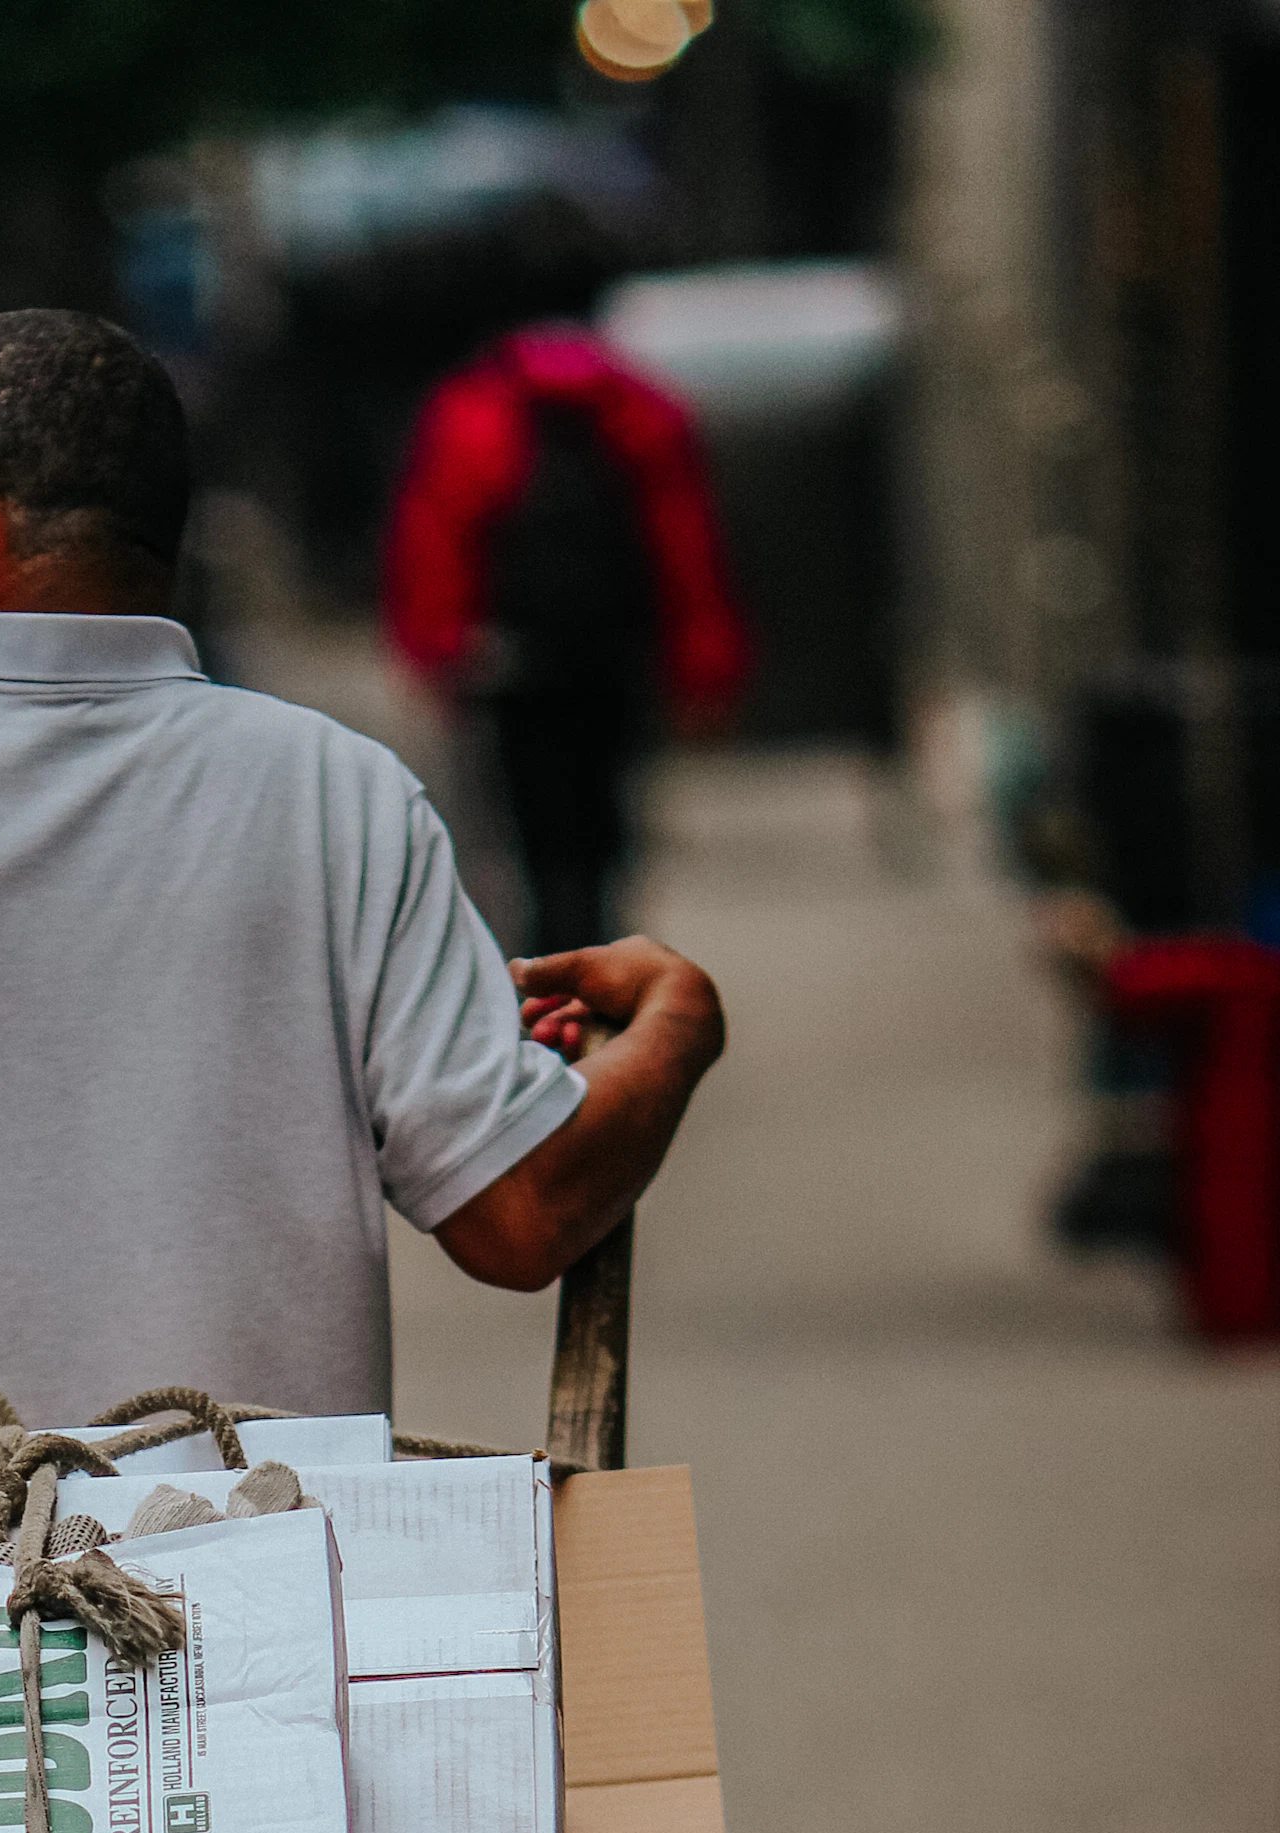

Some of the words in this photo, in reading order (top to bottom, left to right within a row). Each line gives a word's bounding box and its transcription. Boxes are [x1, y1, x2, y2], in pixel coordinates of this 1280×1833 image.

[192, 1621, 203, 1642] JERSEY
[193, 1643, 204, 1660] NEW
[158, 1648, 181, 1735] MANUFACTURI
[161, 1738, 183, 1791] HOLLAND
[169, 1803, 195, 1826] H
[195, 1796, 207, 1832] HOLLAND
